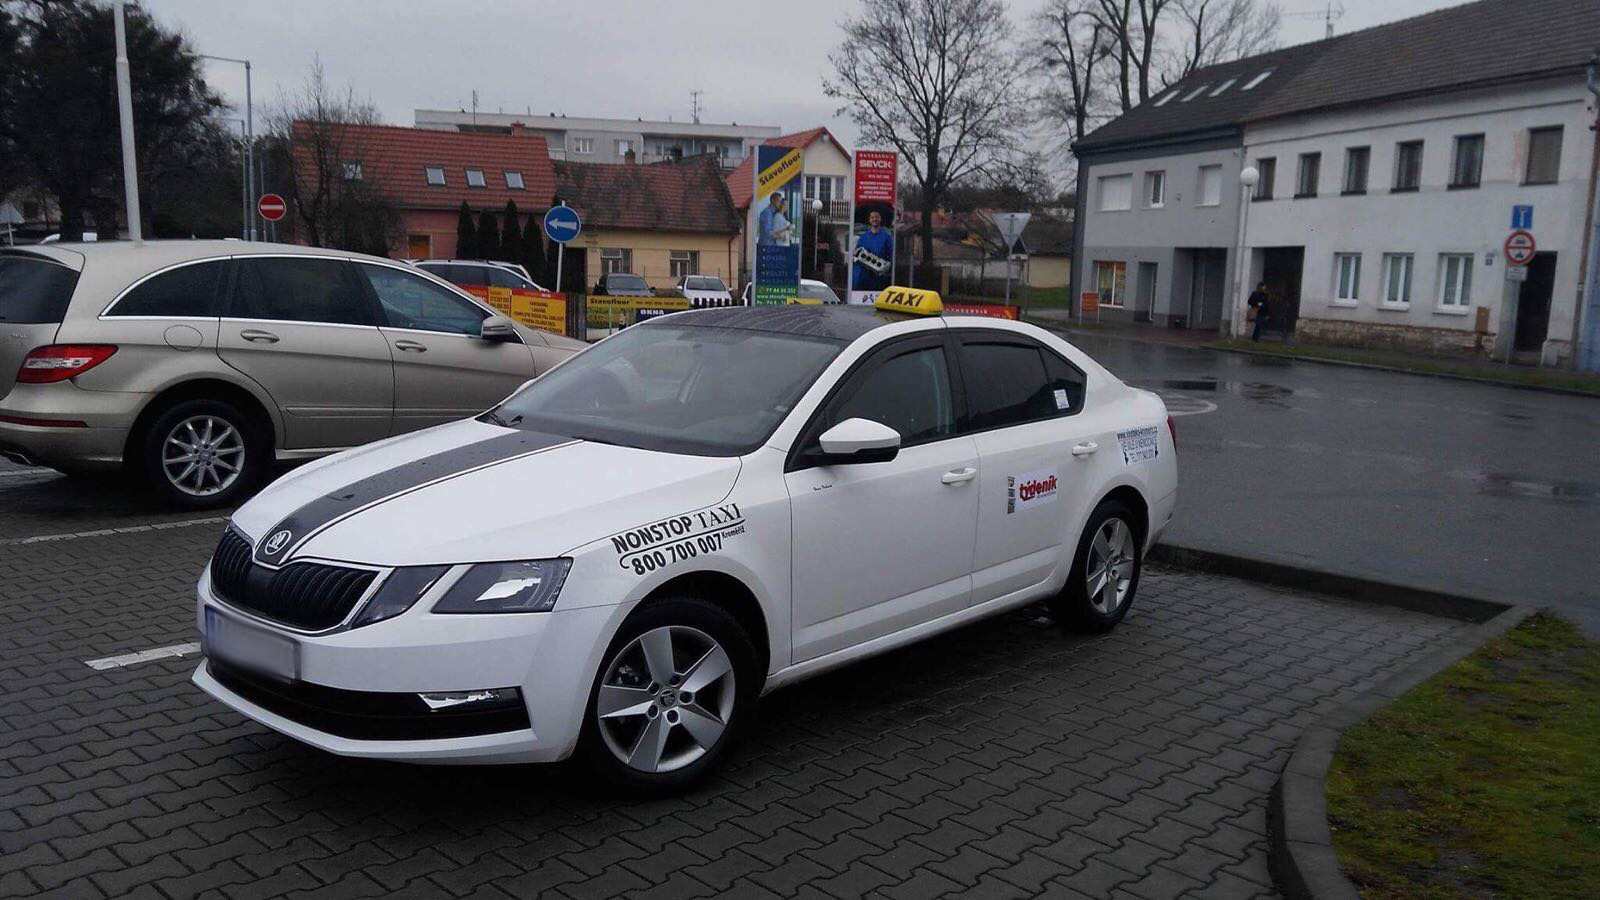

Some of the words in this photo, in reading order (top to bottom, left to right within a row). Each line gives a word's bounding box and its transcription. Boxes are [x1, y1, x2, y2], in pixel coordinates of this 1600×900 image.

[640, 308, 665, 316] OKNA
[884, 290, 925, 307] TAXI
[611, 516, 692, 554] NONSTOP
[694, 503, 742, 529] TAXI
[631, 550, 666, 576] 800
[666, 541, 697, 563] 700
[697, 533, 723, 554] 007
